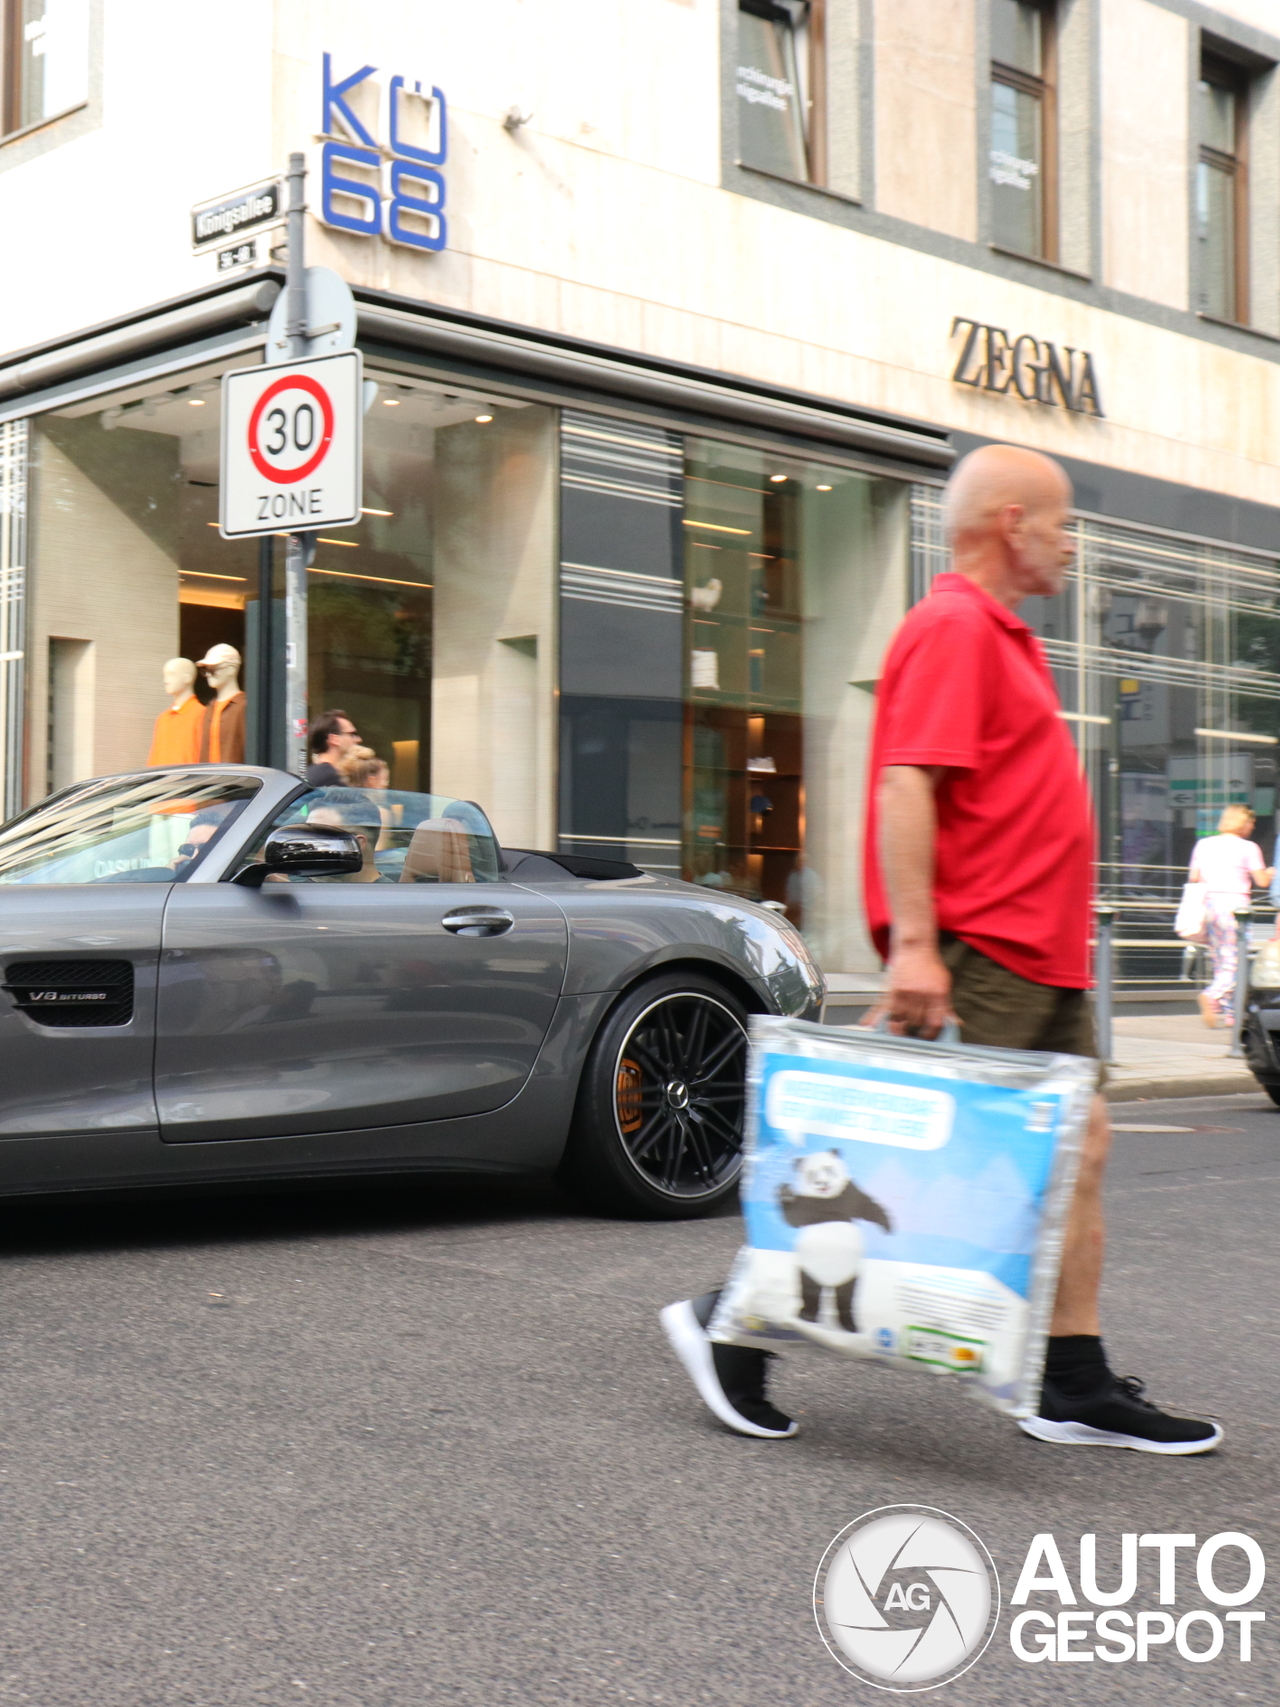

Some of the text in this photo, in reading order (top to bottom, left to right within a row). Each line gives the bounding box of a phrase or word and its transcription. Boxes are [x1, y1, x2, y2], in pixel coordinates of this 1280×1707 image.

[196, 195, 272, 238] Königsallee
[322, 142, 447, 250] 68
[949, 315, 1106, 419] ZEGNA
[265, 403, 314, 455] 30
[257, 488, 323, 520] ZONE
[29, 991, 107, 1001] V8 BITURBO
